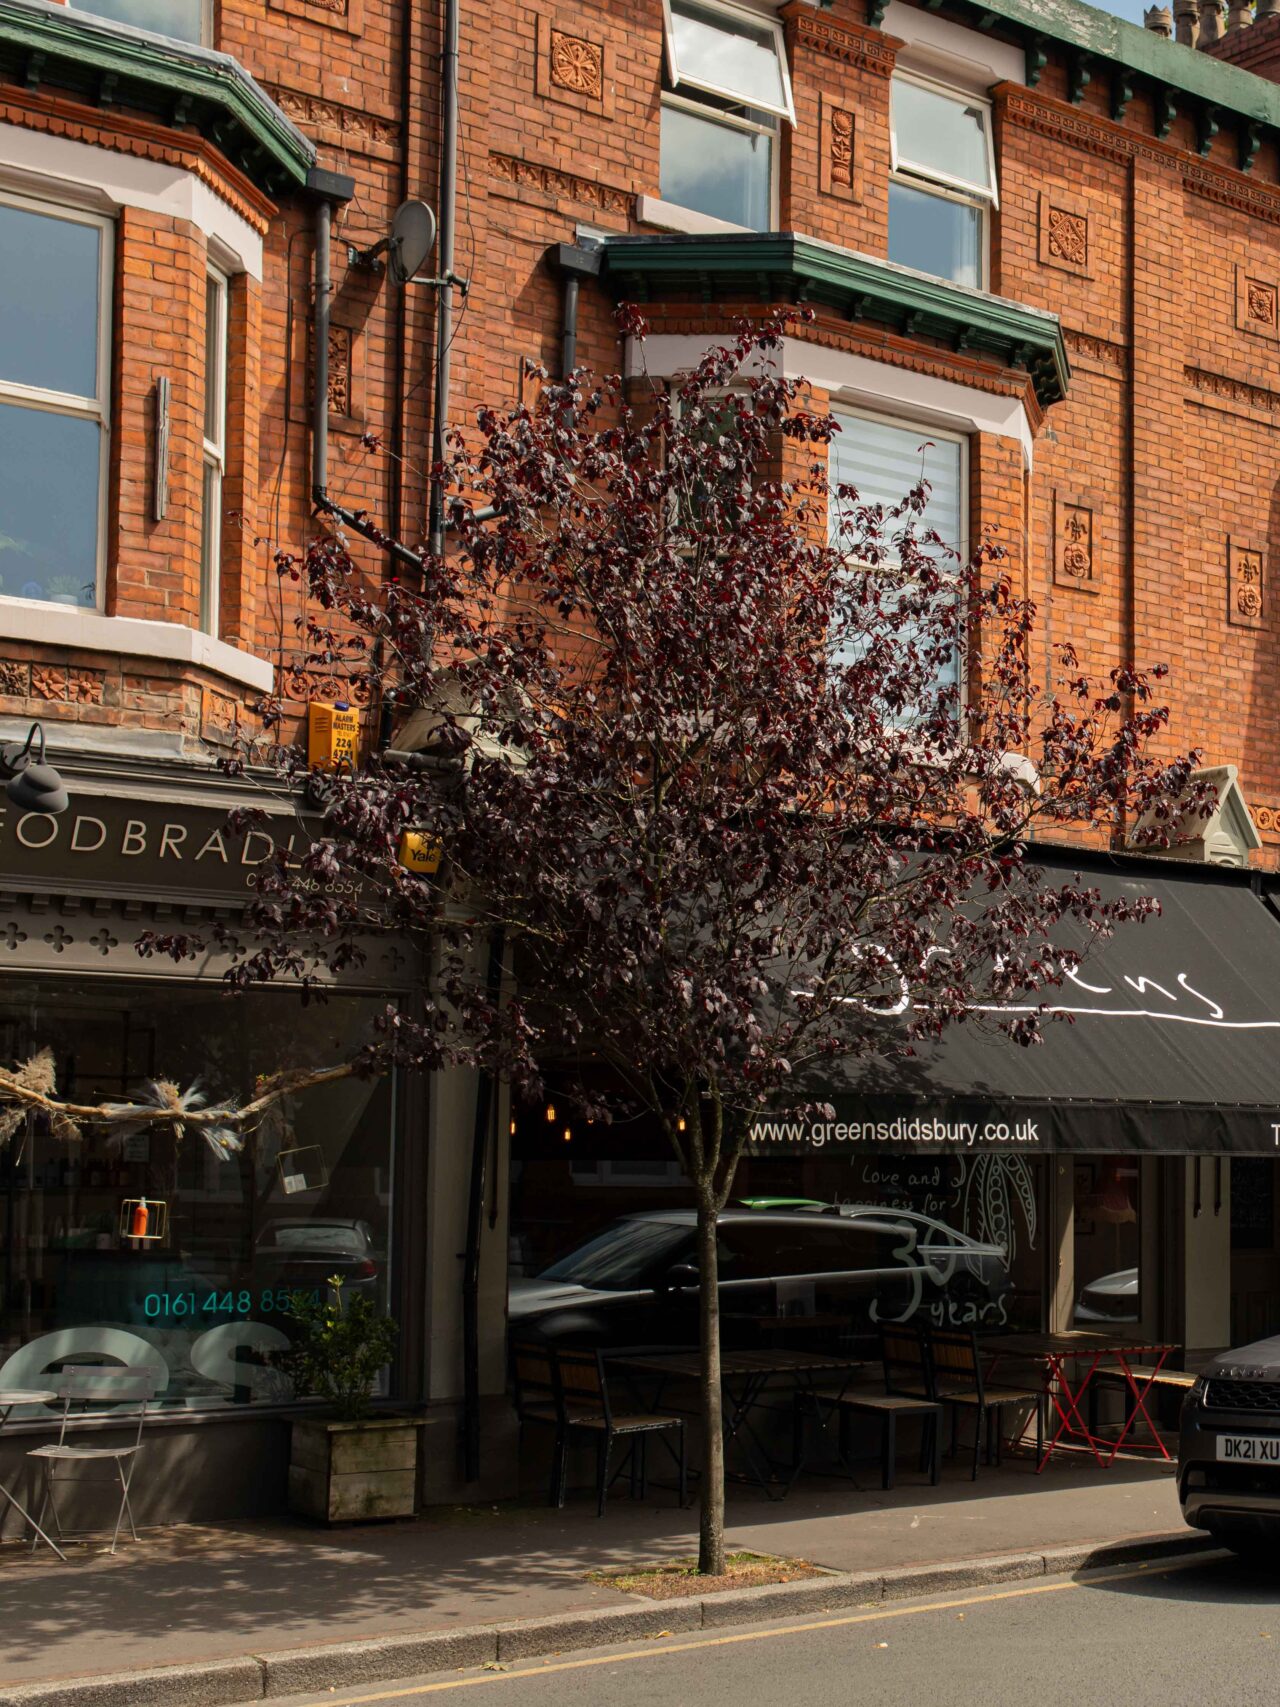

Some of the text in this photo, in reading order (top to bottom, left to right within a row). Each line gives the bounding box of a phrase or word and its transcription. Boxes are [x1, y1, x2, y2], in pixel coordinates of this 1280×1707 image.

[333, 722, 356, 732] MASTERS
[335, 714, 354, 723] ALARM
[336, 738, 352, 749] 224
[0, 808, 335, 868] ODBRADL
[410, 849, 437, 863] Yale
[749, 1118, 1040, 1147] www.greensdidsbury.co.uk
[908, 1165, 941, 1187] and
[921, 1192, 947, 1214] for
[145, 1292, 196, 1317] 0161
[202, 1290, 251, 1313] 448
[929, 1292, 1009, 1328] years
[1225, 1438, 1256, 1460] DK21
